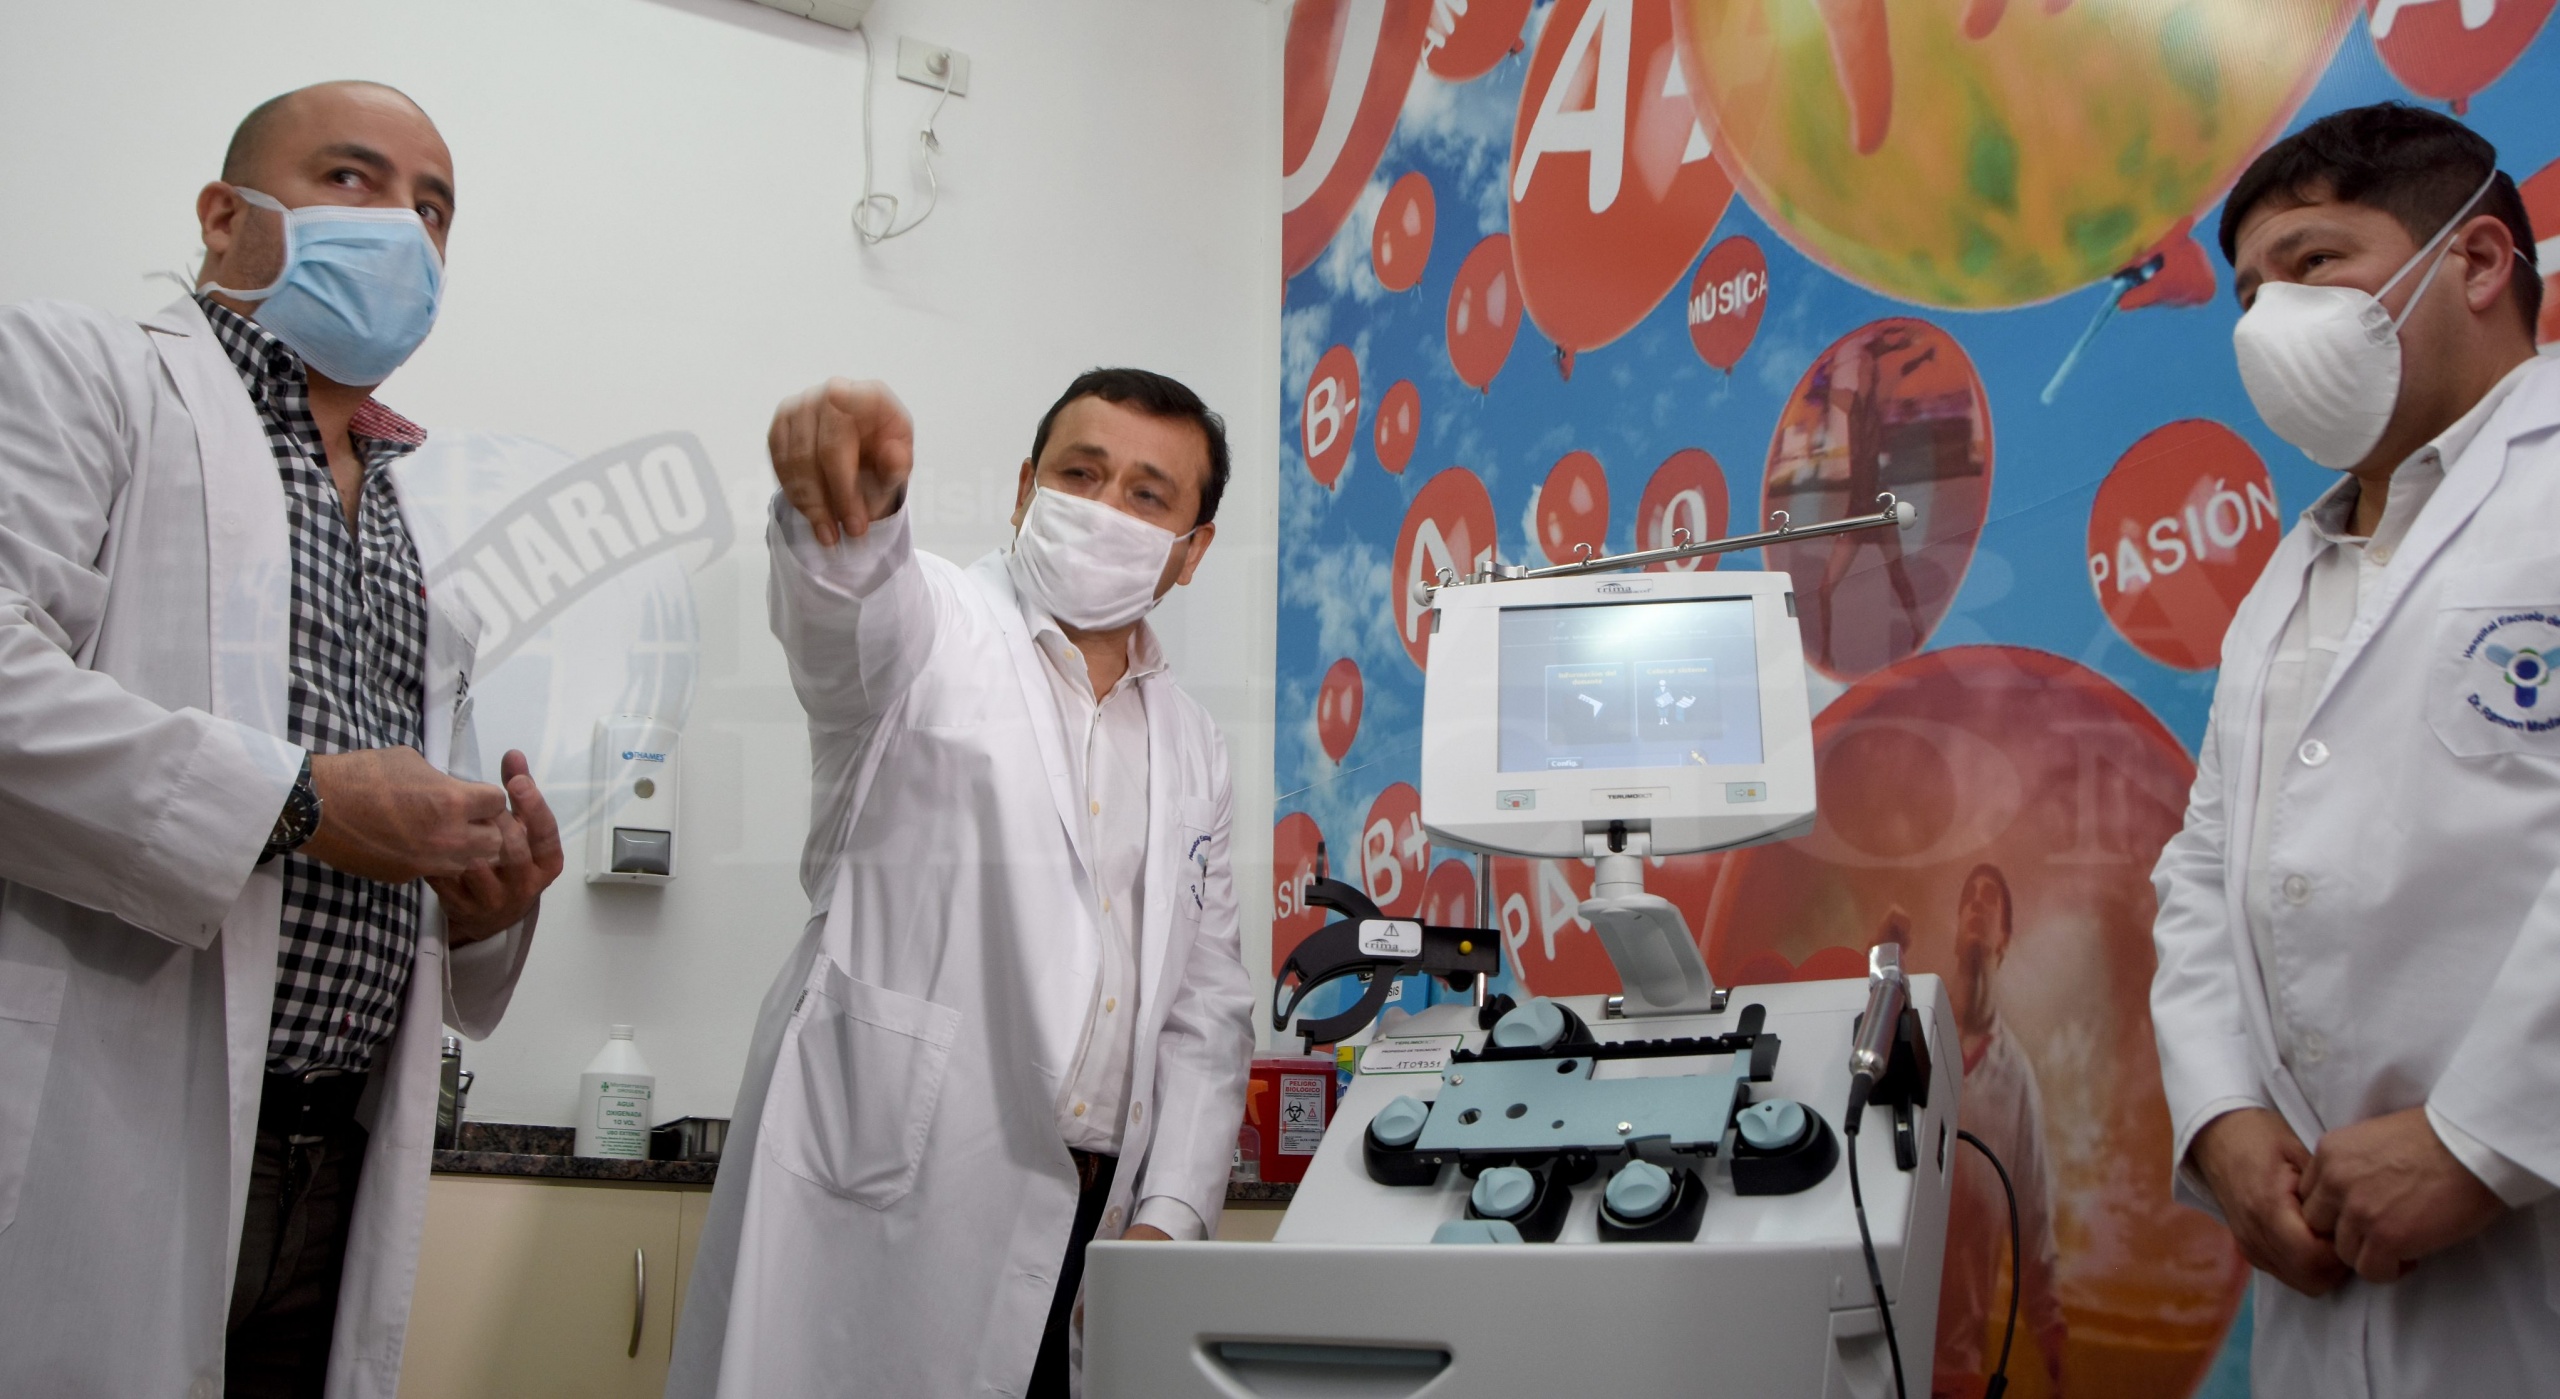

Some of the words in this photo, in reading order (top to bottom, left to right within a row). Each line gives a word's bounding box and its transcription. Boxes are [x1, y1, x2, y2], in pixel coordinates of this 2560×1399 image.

[1689, 271, 1767, 325] MÚSICA
[1307, 376, 1356, 458] B-
[2090, 478, 2279, 600] PASIÓN
[1597, 582, 1632, 594] trima
[634, 751, 664, 760] THAMES
[1551, 760, 1579, 769] Config.
[1364, 811, 1429, 907] B+
[1364, 940, 1399, 951] trima
